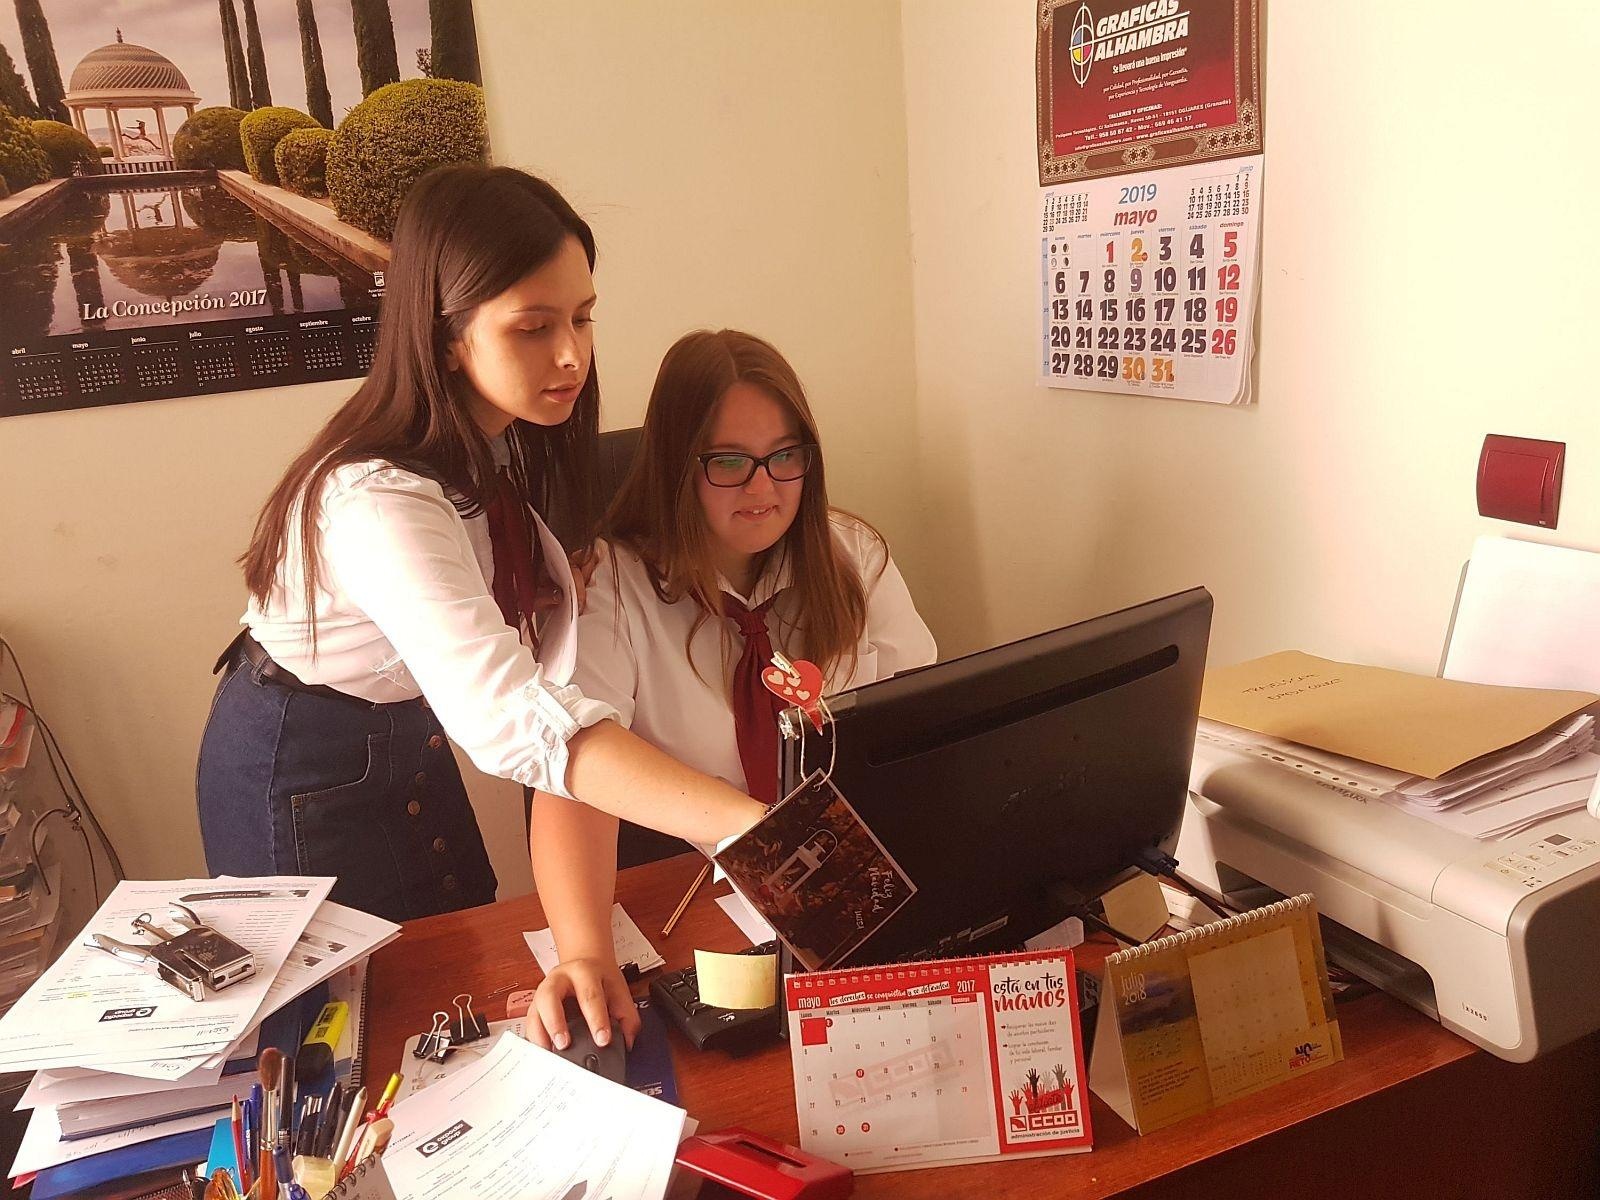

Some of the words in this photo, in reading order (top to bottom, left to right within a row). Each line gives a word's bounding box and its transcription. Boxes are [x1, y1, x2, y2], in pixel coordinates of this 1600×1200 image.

[1097, 0, 1179, 37] GRAFICAS
[1094, 17, 1188, 61] ALHAMBRA
[1113, 66, 1118, 74] Se
[1136, 59, 1144, 67] una
[1118, 183, 1158, 205] 2019
[1113, 208, 1158, 227] mayo
[1106, 240, 1114, 263] 1
[1131, 238, 1143, 261] 2
[1159, 236, 1172, 261] 3
[1190, 233, 1205, 259] 4
[1224, 231, 1238, 258] 5
[1055, 271, 1066, 294] 6
[1079, 270, 1090, 293] 7
[1104, 269, 1115, 293] 8
[1130, 268, 1142, 293] 9
[1154, 266, 1177, 292] 10
[1187, 266, 1206, 291] 11
[1218, 263, 1240, 291] 12
[83, 303, 109, 320] La
[112, 294, 225, 317] Concepción
[229, 289, 267, 308] 2017
[1052, 299, 1069, 320] 13
[1076, 299, 1093, 321] 14
[1100, 298, 1118, 322] 15
[1125, 298, 1146, 322] 16
[1154, 298, 1176, 322] 17
[1183, 297, 1207, 322] 18
[1215, 296, 1238, 323] 19
[300, 319, 328, 328] septiembre
[1051, 325, 1071, 348] 20
[1075, 326, 1092, 349] 21
[1098, 326, 1119, 350] 22
[1123, 328, 1147, 351] 23
[1150, 328, 1177, 352] 24
[1181, 328, 1207, 354] 25
[1211, 328, 1237, 356] 26
[1052, 352, 1071, 375] 27
[1073, 353, 1094, 377] 28
[1097, 354, 1119, 379] 29
[1122, 356, 1146, 381] 30
[1151, 358, 1175, 383] 31
[881, 870, 895, 898] Feliz
[798, 996, 820, 1009] mayo
[957, 980, 975, 992] 2017
[994, 976, 1020, 994] está
[1025, 980, 1040, 990] en
[1040, 972, 1063, 990] tus
[994, 989, 1065, 1012] manos
[437, 1123, 463, 1142] expedia
[1032, 1114, 1076, 1127] CCOO
[441, 1130, 460, 1145] group
